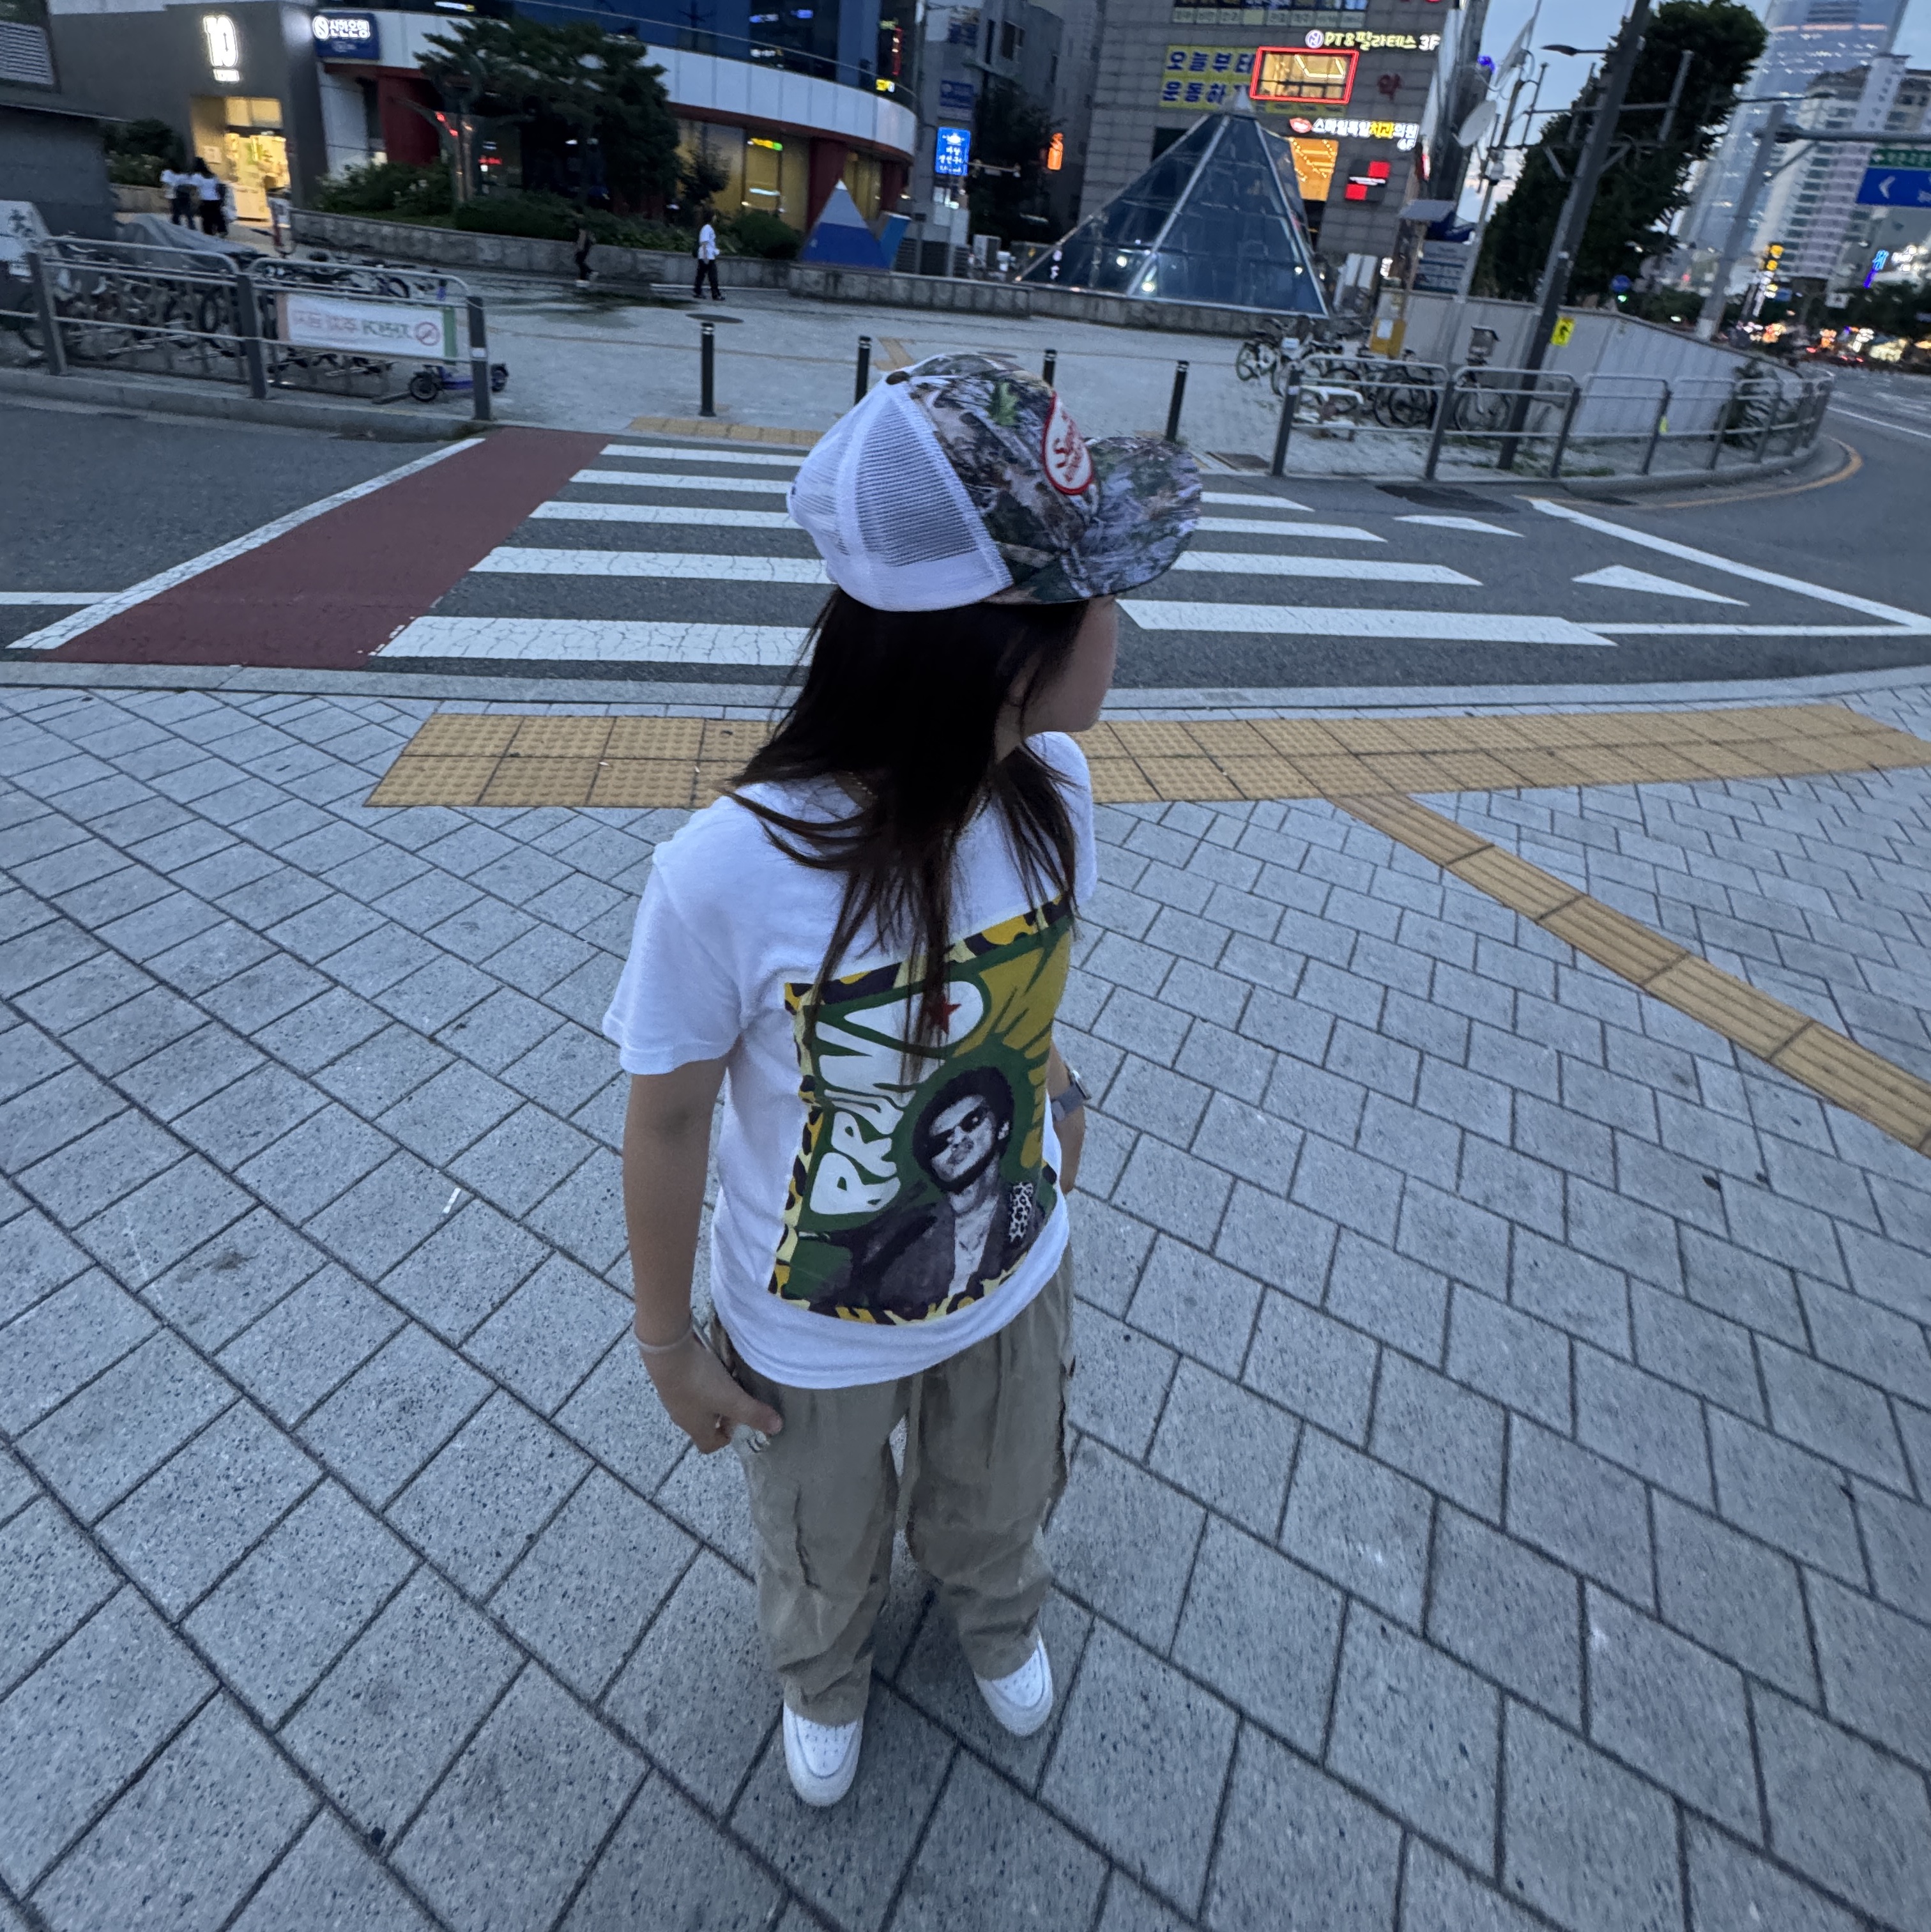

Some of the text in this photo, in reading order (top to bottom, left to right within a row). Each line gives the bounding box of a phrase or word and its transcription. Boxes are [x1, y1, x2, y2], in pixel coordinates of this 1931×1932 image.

[330, 20, 370, 38] 신한은행
[1324, 31, 1441, 51] PT&필라테스 3F
[1166, 51, 1255, 73] 오늘부터
[1378, 73, 1402, 100] 약
[1397, 138, 1417, 151] 6F
[809, 981, 984, 1215] BRUNO
